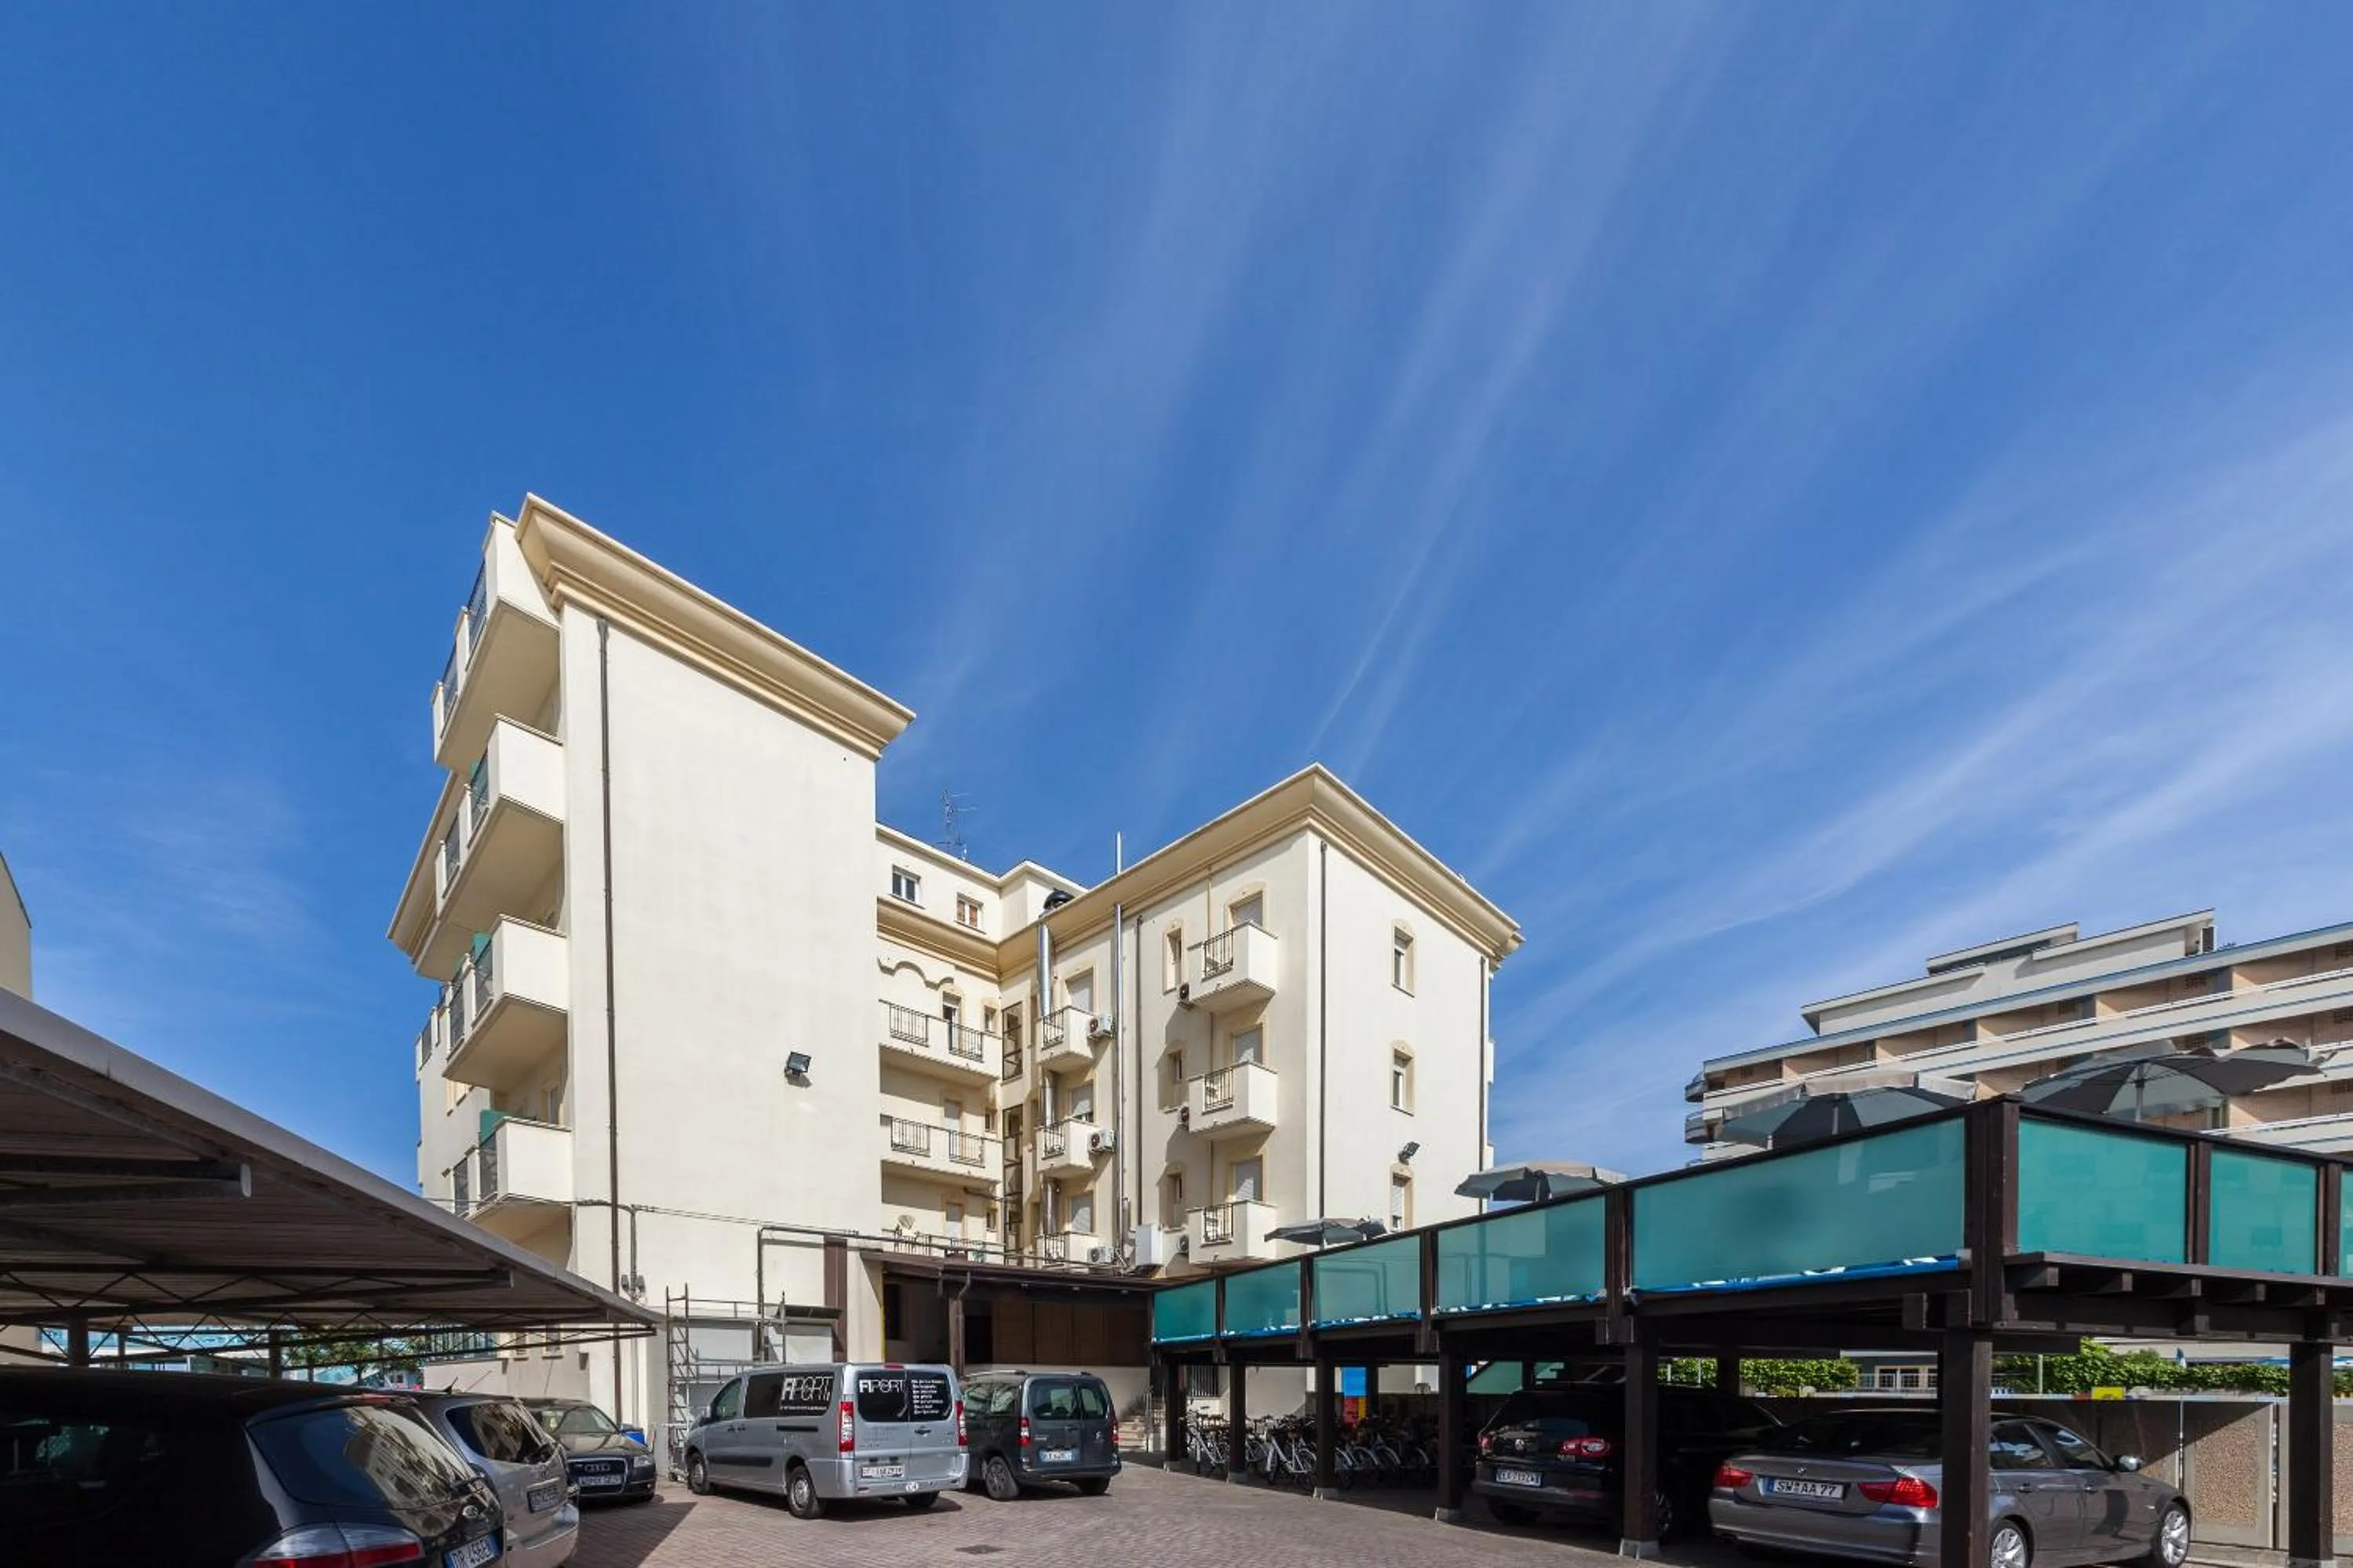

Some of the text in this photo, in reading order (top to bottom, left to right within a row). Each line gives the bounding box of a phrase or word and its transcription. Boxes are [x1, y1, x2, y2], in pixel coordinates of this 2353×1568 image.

[1776, 1481, 1838, 1495] SW AA 77
